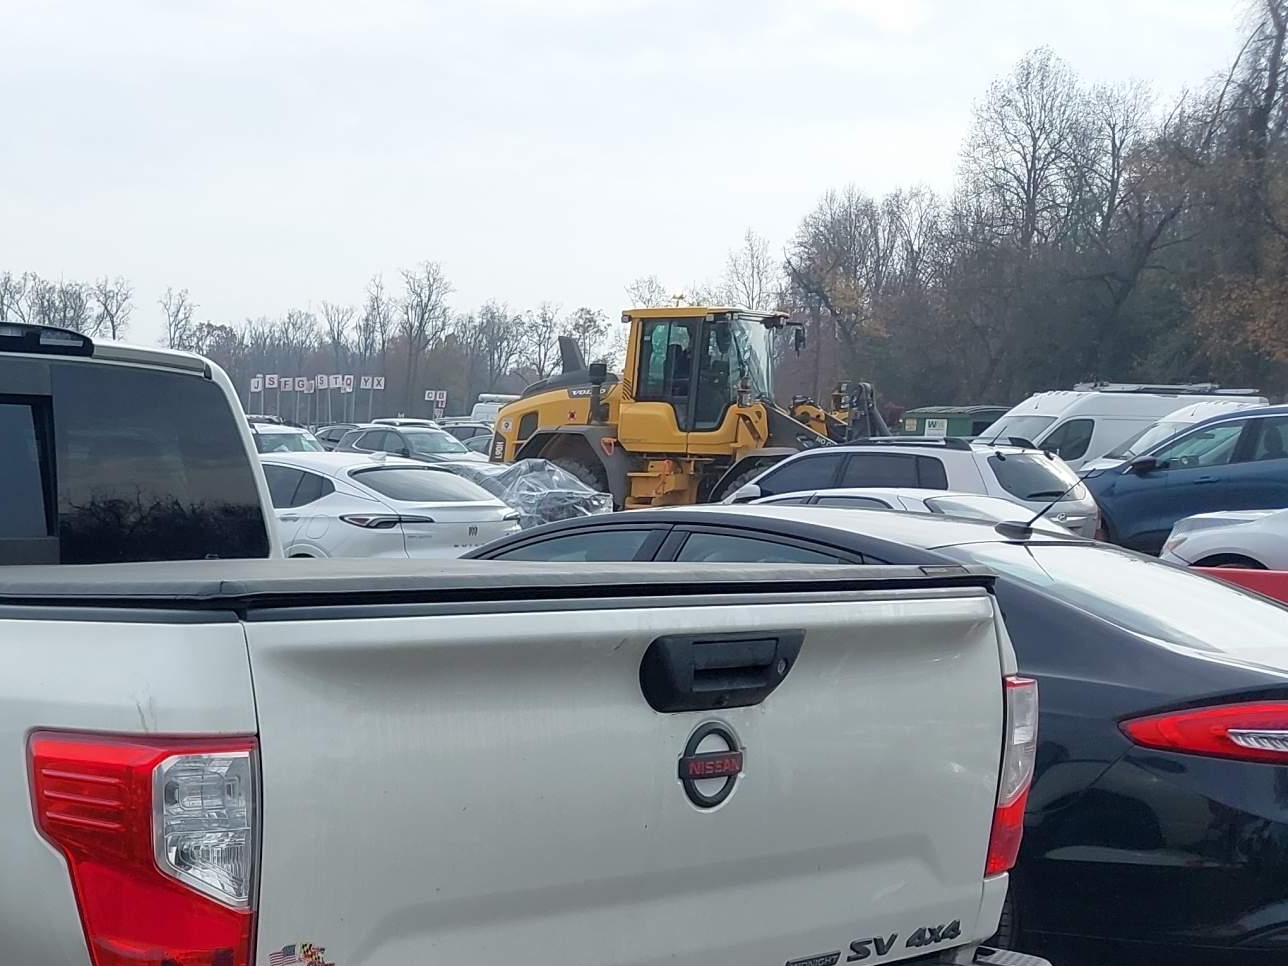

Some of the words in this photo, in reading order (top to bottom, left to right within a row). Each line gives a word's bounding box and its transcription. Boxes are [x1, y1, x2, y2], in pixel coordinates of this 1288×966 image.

[571, 388, 607, 397] VOLO
[688, 757, 740, 775] NISSAN
[846, 932, 899, 963] SV
